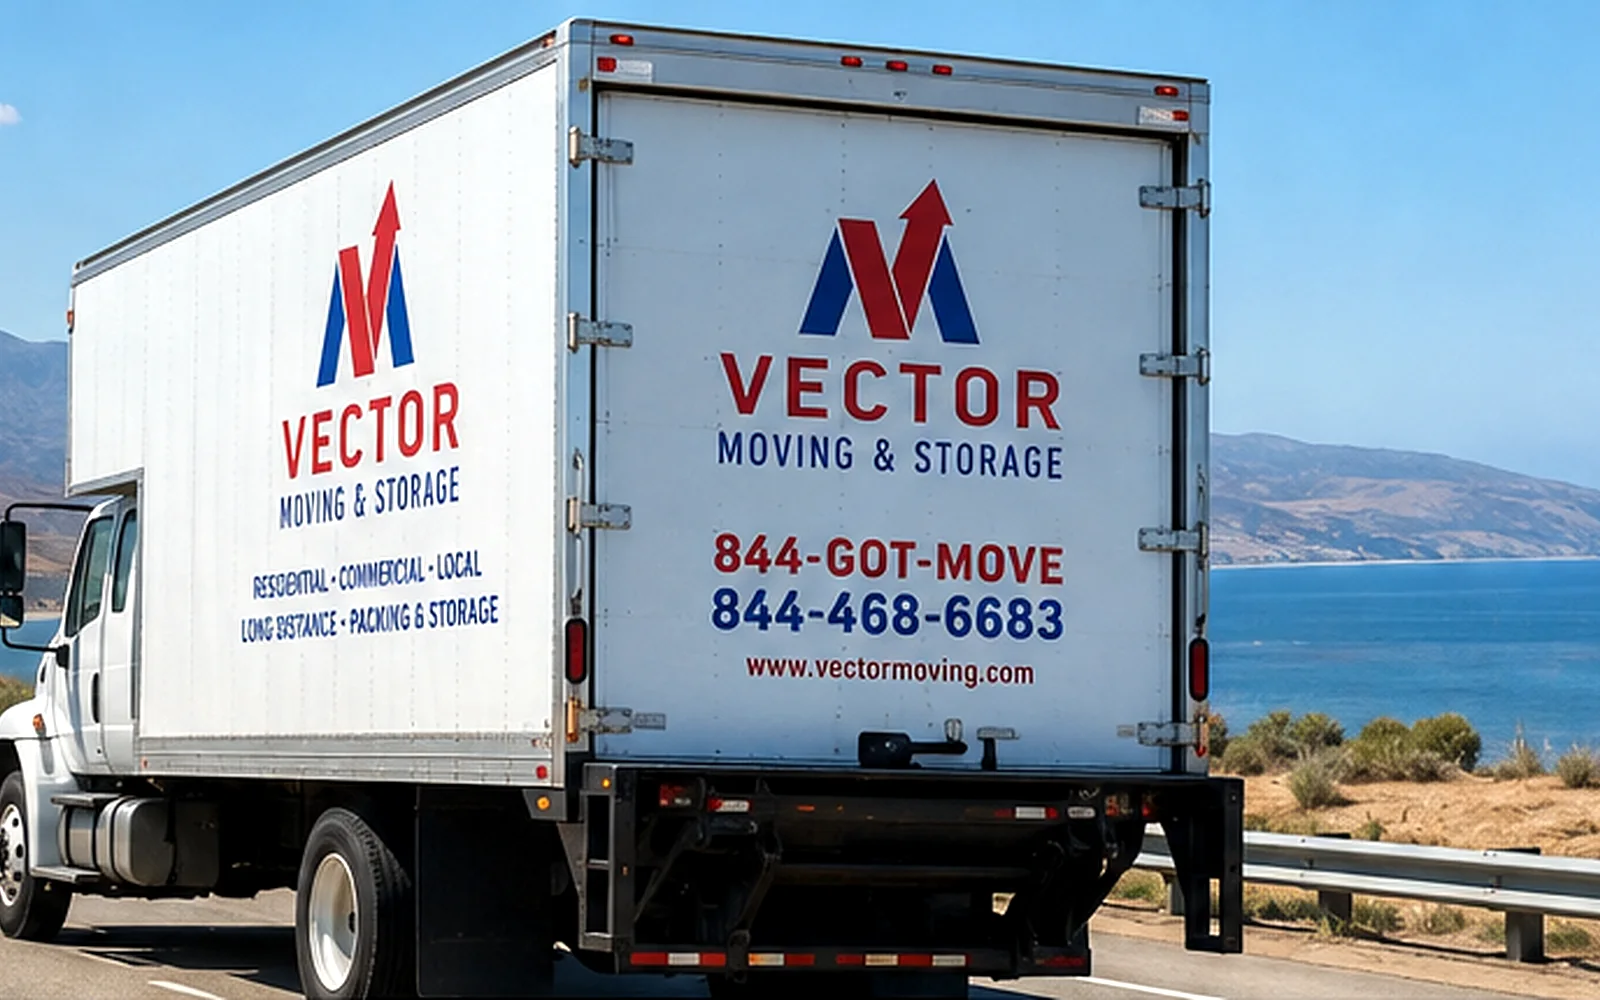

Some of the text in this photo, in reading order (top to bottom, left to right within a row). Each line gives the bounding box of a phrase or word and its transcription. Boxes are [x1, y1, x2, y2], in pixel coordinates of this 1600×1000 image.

[721, 351, 1061, 430] VECTOR
[281, 381, 460, 480] VECTOR
[718, 430, 1063, 479] MOVING & STORAGE
[279, 466, 460, 529] MOVING & STORAGE
[436, 550, 482, 580] LOCAL
[713, 532, 1064, 585] 844-GOT-MOVE
[349, 602, 410, 634] PACKING
[428, 594, 499, 629] STORAGE
[711, 587, 1064, 640] 844-468-6683
[747, 657, 1035, 688] www.vectormoving.com
